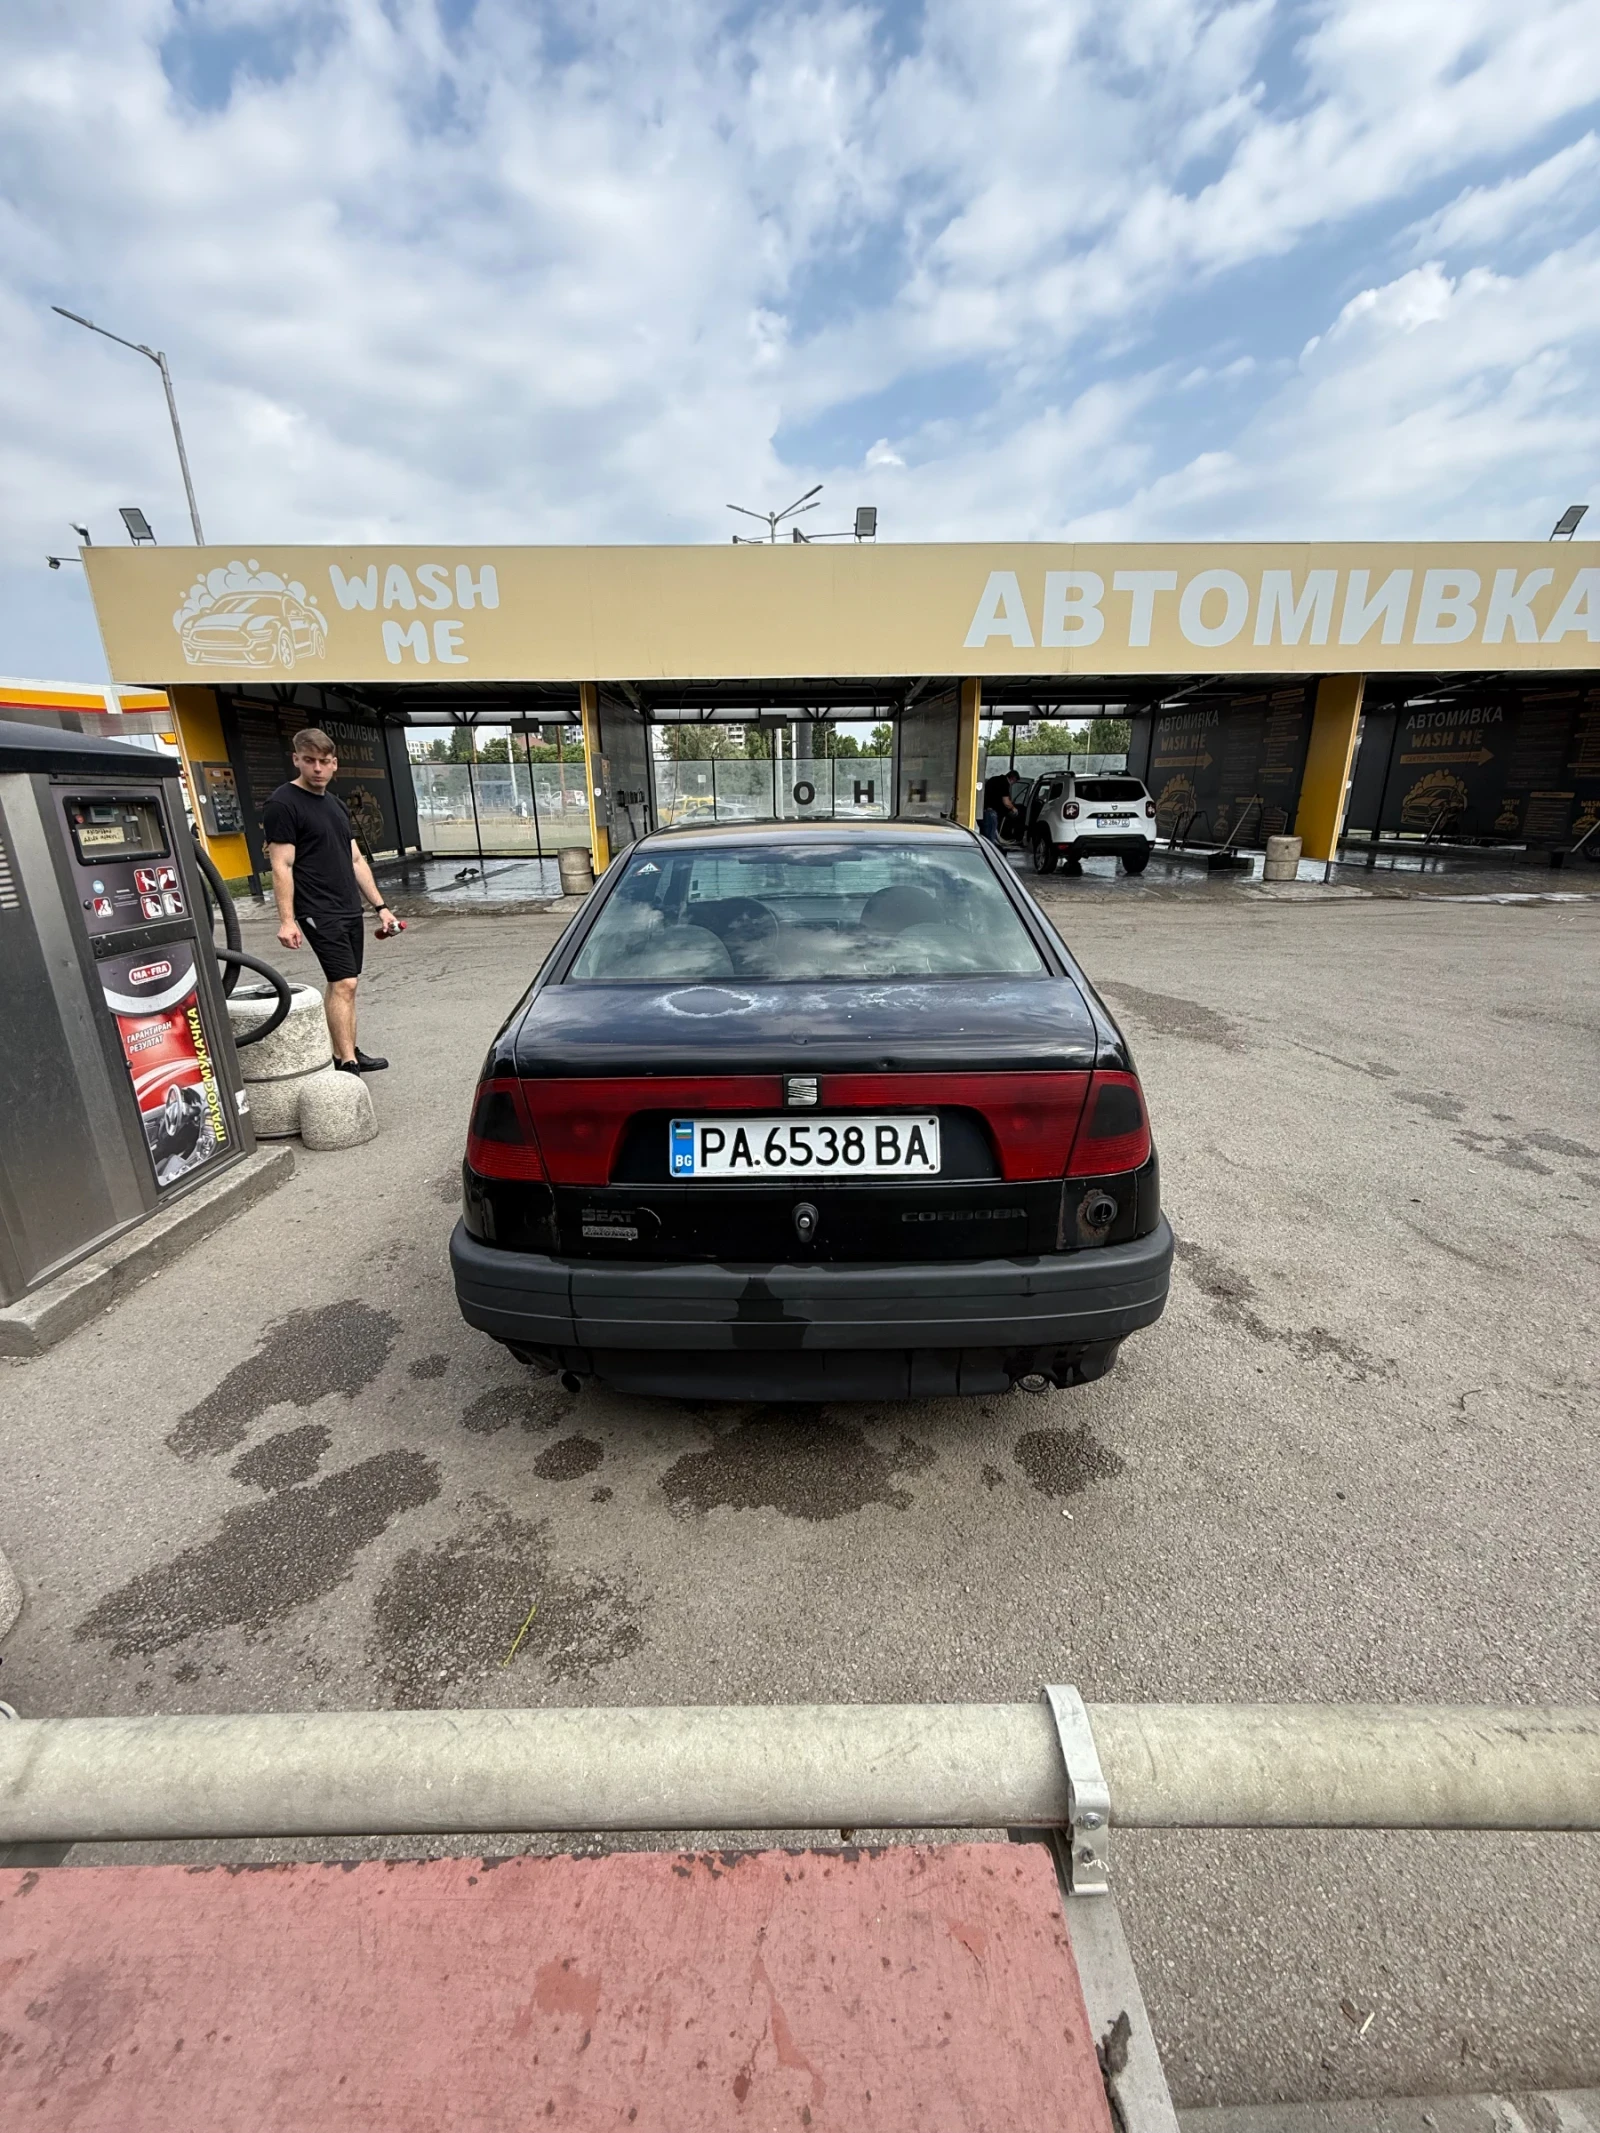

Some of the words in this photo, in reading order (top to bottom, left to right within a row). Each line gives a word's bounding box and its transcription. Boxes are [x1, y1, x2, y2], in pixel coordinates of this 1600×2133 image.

[329, 564, 500, 611] WASH
[962, 567, 1600, 648] АВТОМИВКА
[381, 620, 469, 665] ME
[1157, 709, 1219, 733] АВТОМИВКА
[1405, 705, 1504, 730] АВТОМИВКА
[1161, 735, 1189, 752] WASH
[1190, 733, 1207, 749] ME
[1411, 731, 1454, 748] WASH
[1458, 729, 1485, 746] ME
[126, 1020, 172, 1044] ГАРАНТИРАН
[129, 1034, 164, 1055] РЕЗУЛТАТ
[186, 1007, 227, 1143] ПРАХОСМУКАЧКА
[675, 1155, 693, 1167] BG
[581, 1208, 636, 1223] SEAT
[901, 1207, 1029, 1223] CORDOBA
